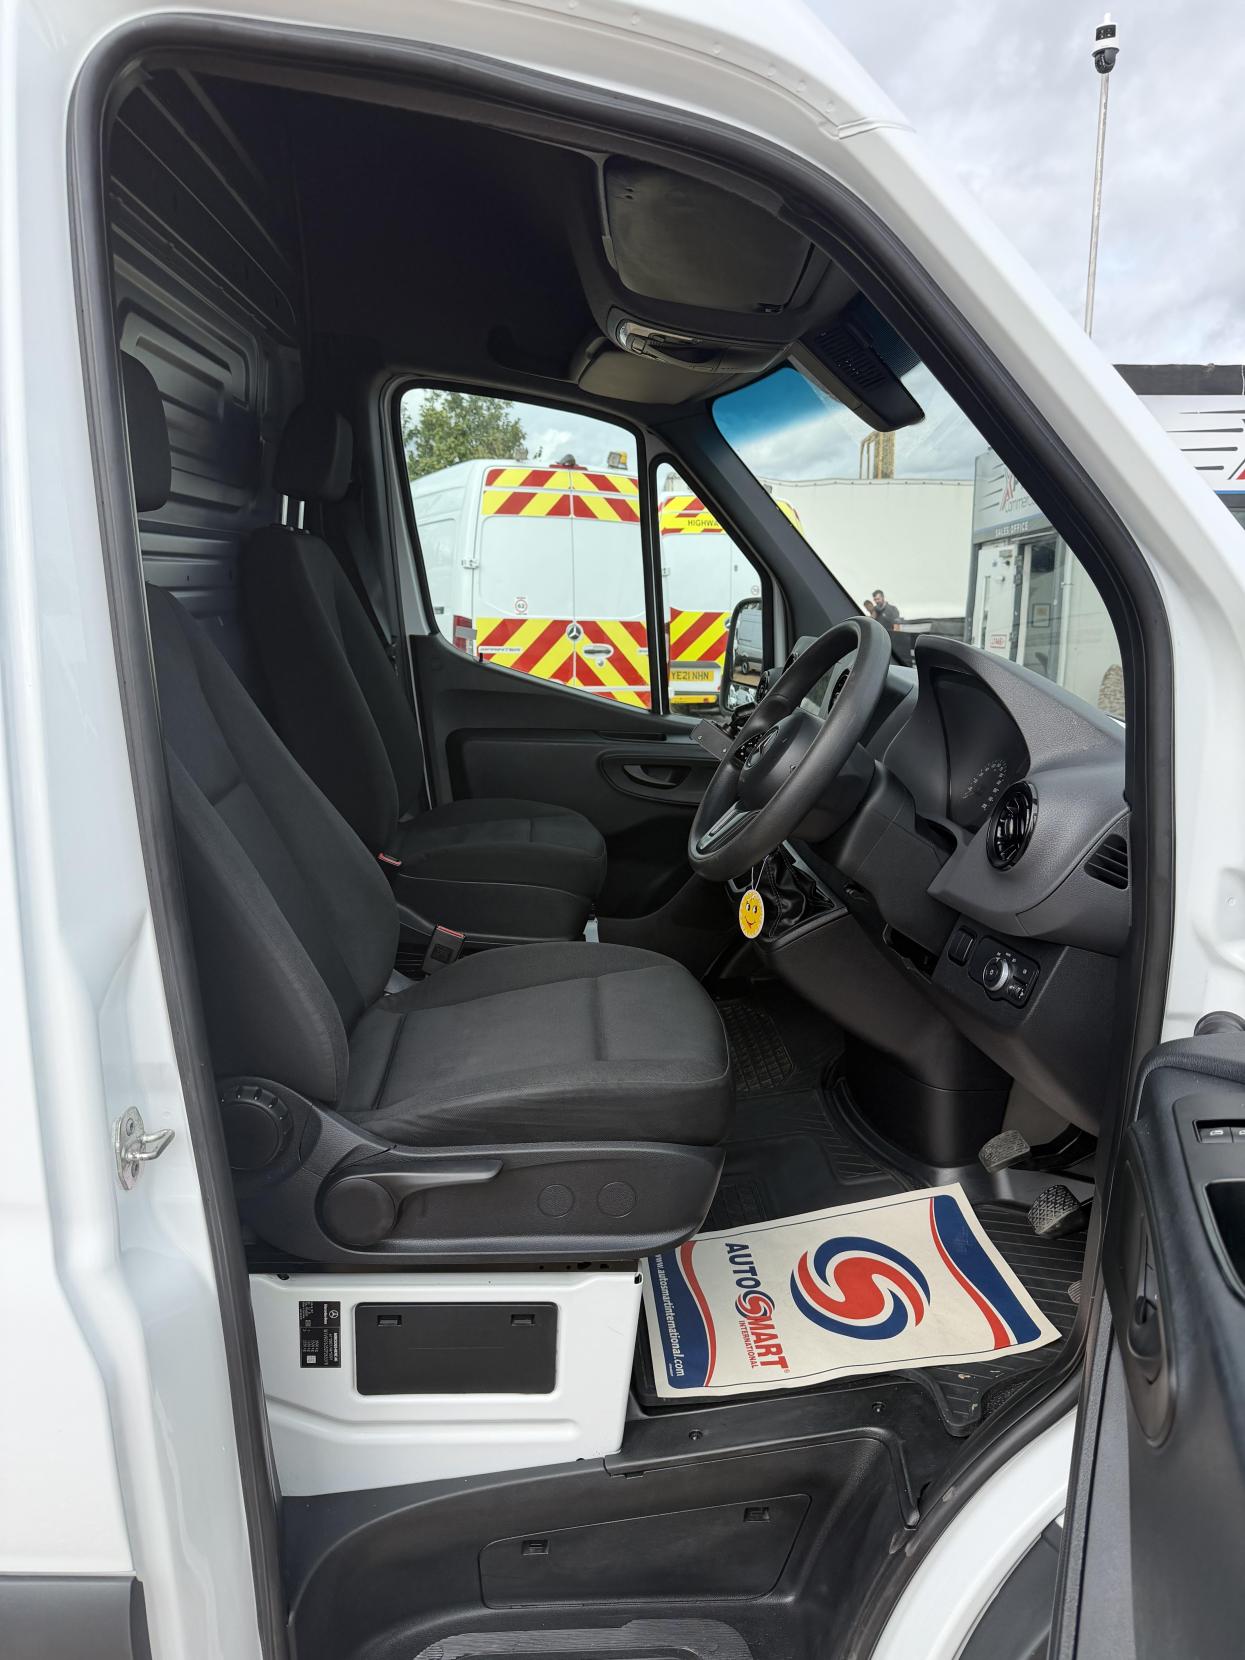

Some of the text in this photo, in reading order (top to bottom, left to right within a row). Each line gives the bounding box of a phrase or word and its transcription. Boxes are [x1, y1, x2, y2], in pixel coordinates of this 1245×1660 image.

[995, 521, 1028, 537] SALES OFFICE
[692, 671, 709, 680] NHN
[739, 1320, 758, 1368] INTERNATIONAL
